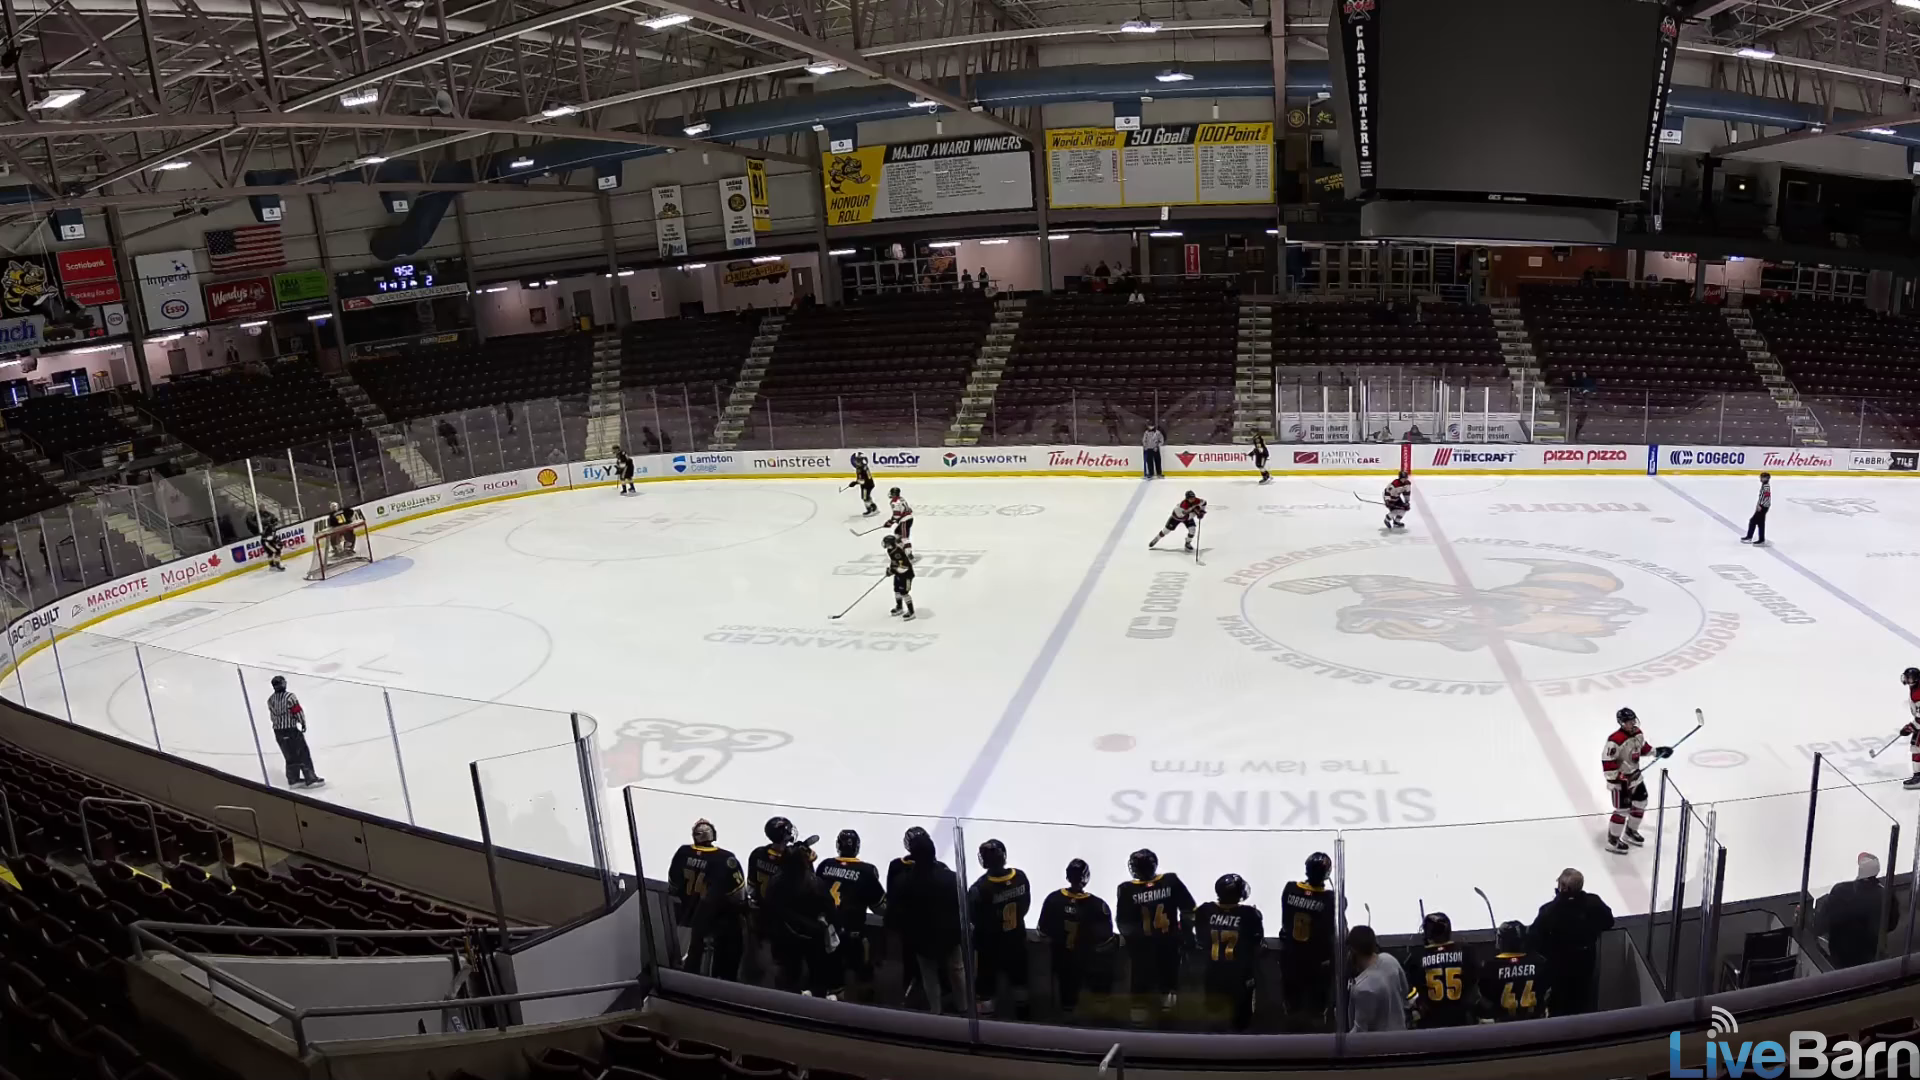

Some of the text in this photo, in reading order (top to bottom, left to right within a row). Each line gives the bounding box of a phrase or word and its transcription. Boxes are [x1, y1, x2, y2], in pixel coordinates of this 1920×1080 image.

[1355, 24, 1370, 158] CARPENTERS
[1131, 128, 1152, 146] 50
[1154, 127, 1186, 144] Goal
[1199, 126, 1225, 142] 100
[1223, 125, 1262, 142] Point
[892, 136, 1023, 161] MAJOR AWARD WINNERS
[1052, 136, 1080, 147] World
[1095, 136, 1116, 147] Gold
[830, 194, 870, 211] HONOUR
[838, 209, 861, 224] ROLL
[146, 272, 192, 287] Imperial
[211, 286, 249, 307] Wendy's
[165, 303, 185, 314] Esso
[690, 455, 733, 464] Lambton
[754, 456, 831, 468] mainstreet
[872, 452, 920, 465] LamSar
[959, 454, 1027, 464] AINSWORTH
[1047, 450, 1129, 467] Tim Hortons
[1199, 452, 1247, 462] CANADIAN
[1321, 451, 1360, 459] LAMBTON
[1453, 453, 1515, 462] TIRECRAFT
[1543, 450, 1627, 464] pizza pizza
[1763, 451, 1832, 467] Tim Hortons
[1853, 457, 1914, 467] FABBRI TILE
[583, 464, 649, 481] flyY.ca
[691, 464, 717, 472] College
[483, 479, 518, 491] RICOH
[246, 540, 262, 551] REA
[160, 561, 209, 586] Maple
[87, 577, 149, 607] MARCOTTE
[703, 631, 934, 653] ADVANCED
[1216, 610, 1740, 697] PROGRESSIVE AUTO SALES ARENA
[1150, 758, 1400, 778] The law firm
[1106, 787, 1437, 826] SISKINDS
[686, 856, 708, 869] ROTH
[822, 866, 861, 881] SAUNDERS
[1132, 886, 1172, 904] SHERMAN
[1209, 913, 1242, 927] CHATE
[1421, 951, 1463, 967] ROBERTSON
[1498, 964, 1536, 979] FRASER
[1425, 966, 1464, 1002] 55
[1500, 980, 1537, 1017] 44
